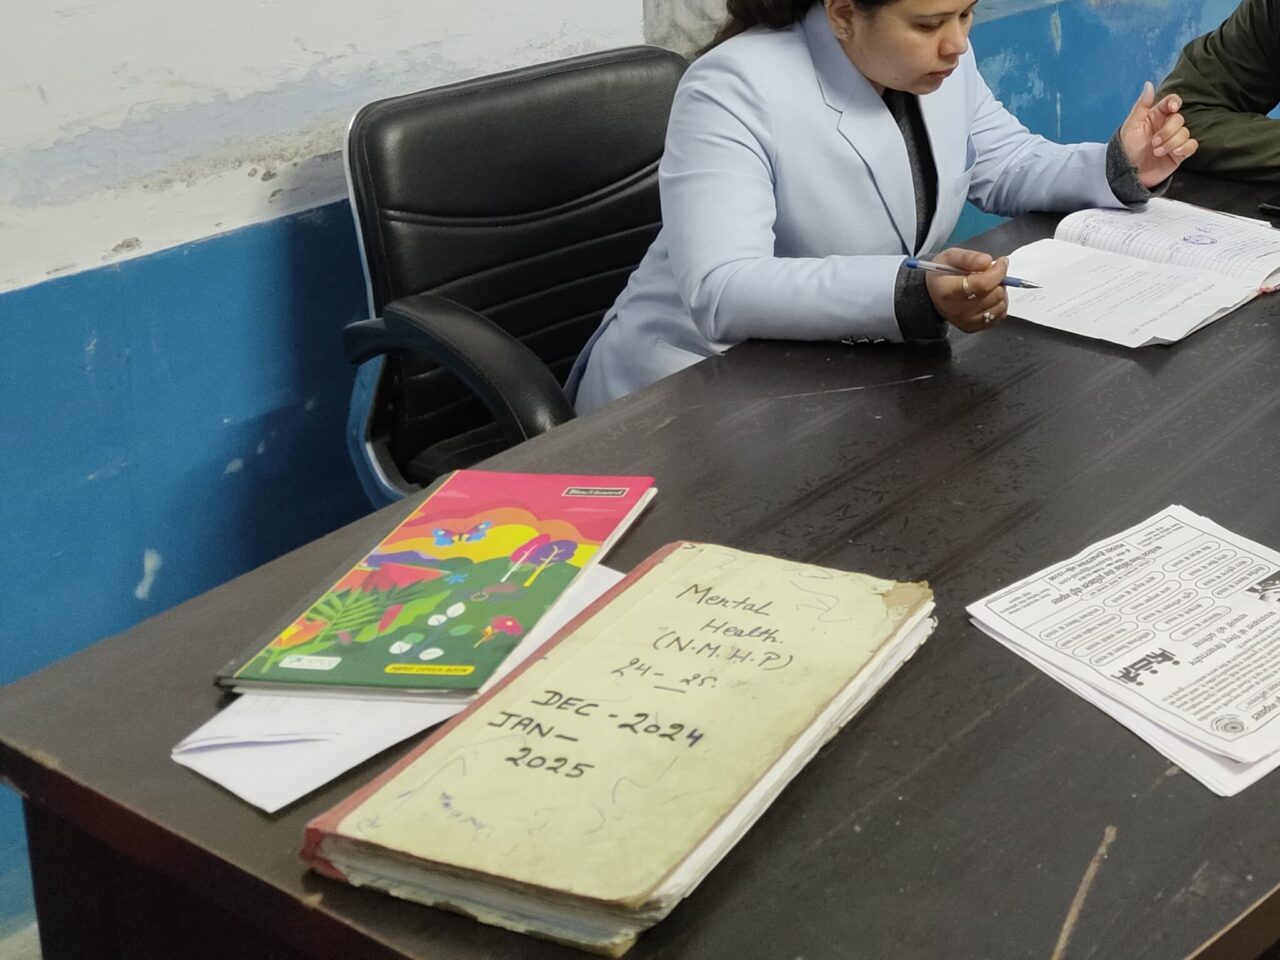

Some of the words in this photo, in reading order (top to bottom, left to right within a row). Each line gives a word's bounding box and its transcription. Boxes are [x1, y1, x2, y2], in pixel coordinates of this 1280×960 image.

[676, 582, 770, 617] Mental
[531, 690, 599, 718] DEC
[505, 747, 595, 779] 2025
